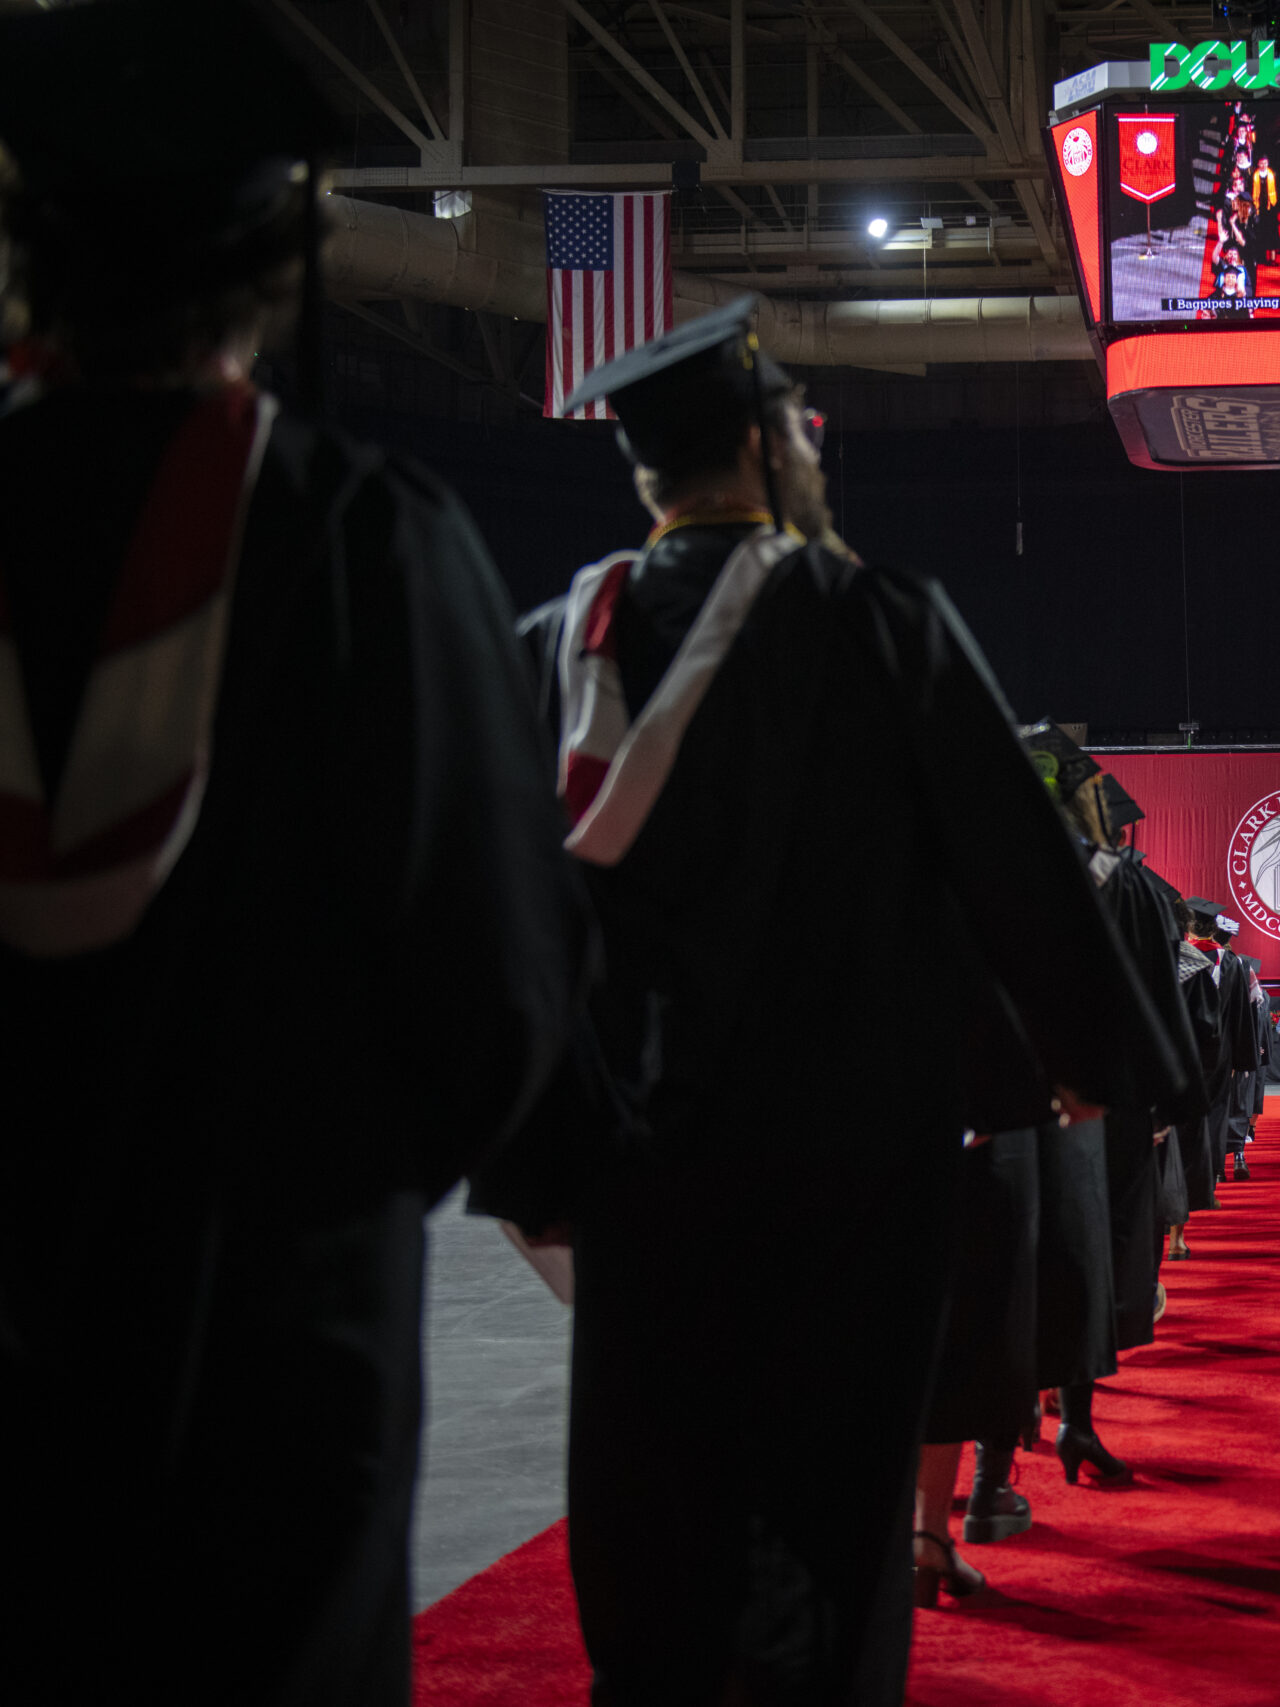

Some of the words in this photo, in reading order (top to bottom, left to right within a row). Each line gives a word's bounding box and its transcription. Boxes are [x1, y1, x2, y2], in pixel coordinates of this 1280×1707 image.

[1150, 40, 1276, 91] DCU
[1122, 159, 1171, 170] CLARK
[1177, 299, 1232, 311] Bagpipes
[1235, 297, 1280, 310] playing
[1185, 397, 1268, 460] RAILERS
[1233, 801, 1277, 875] CLARK
